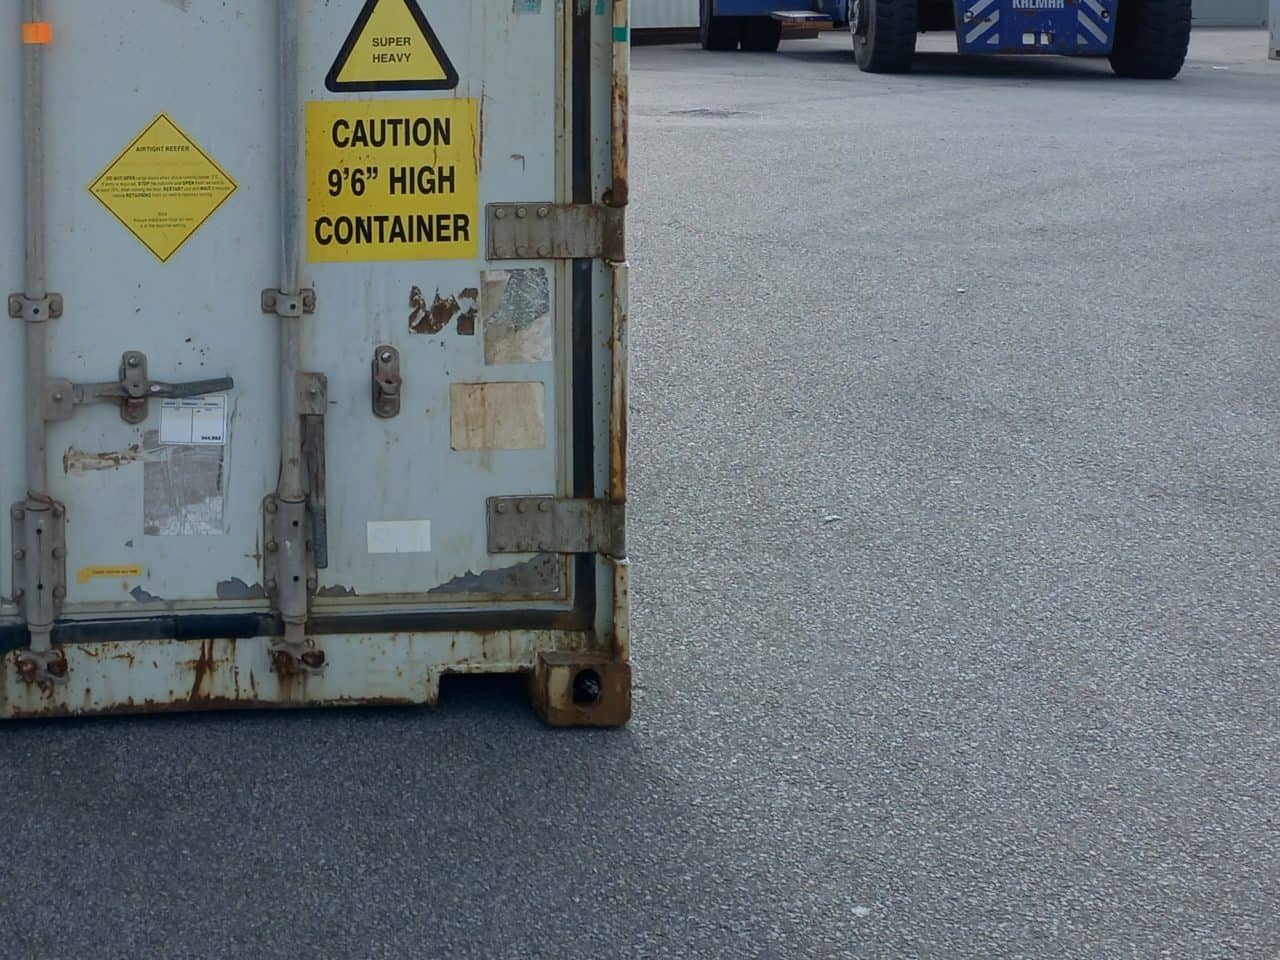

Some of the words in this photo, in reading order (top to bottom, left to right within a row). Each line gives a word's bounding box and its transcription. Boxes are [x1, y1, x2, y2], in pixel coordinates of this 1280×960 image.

[372, 37, 411, 47] SUPER
[373, 53, 411, 63] HEAVY
[332, 118, 450, 148] CAUTION
[390, 166, 454, 194] HIGH
[315, 214, 469, 245] CONTAINER
